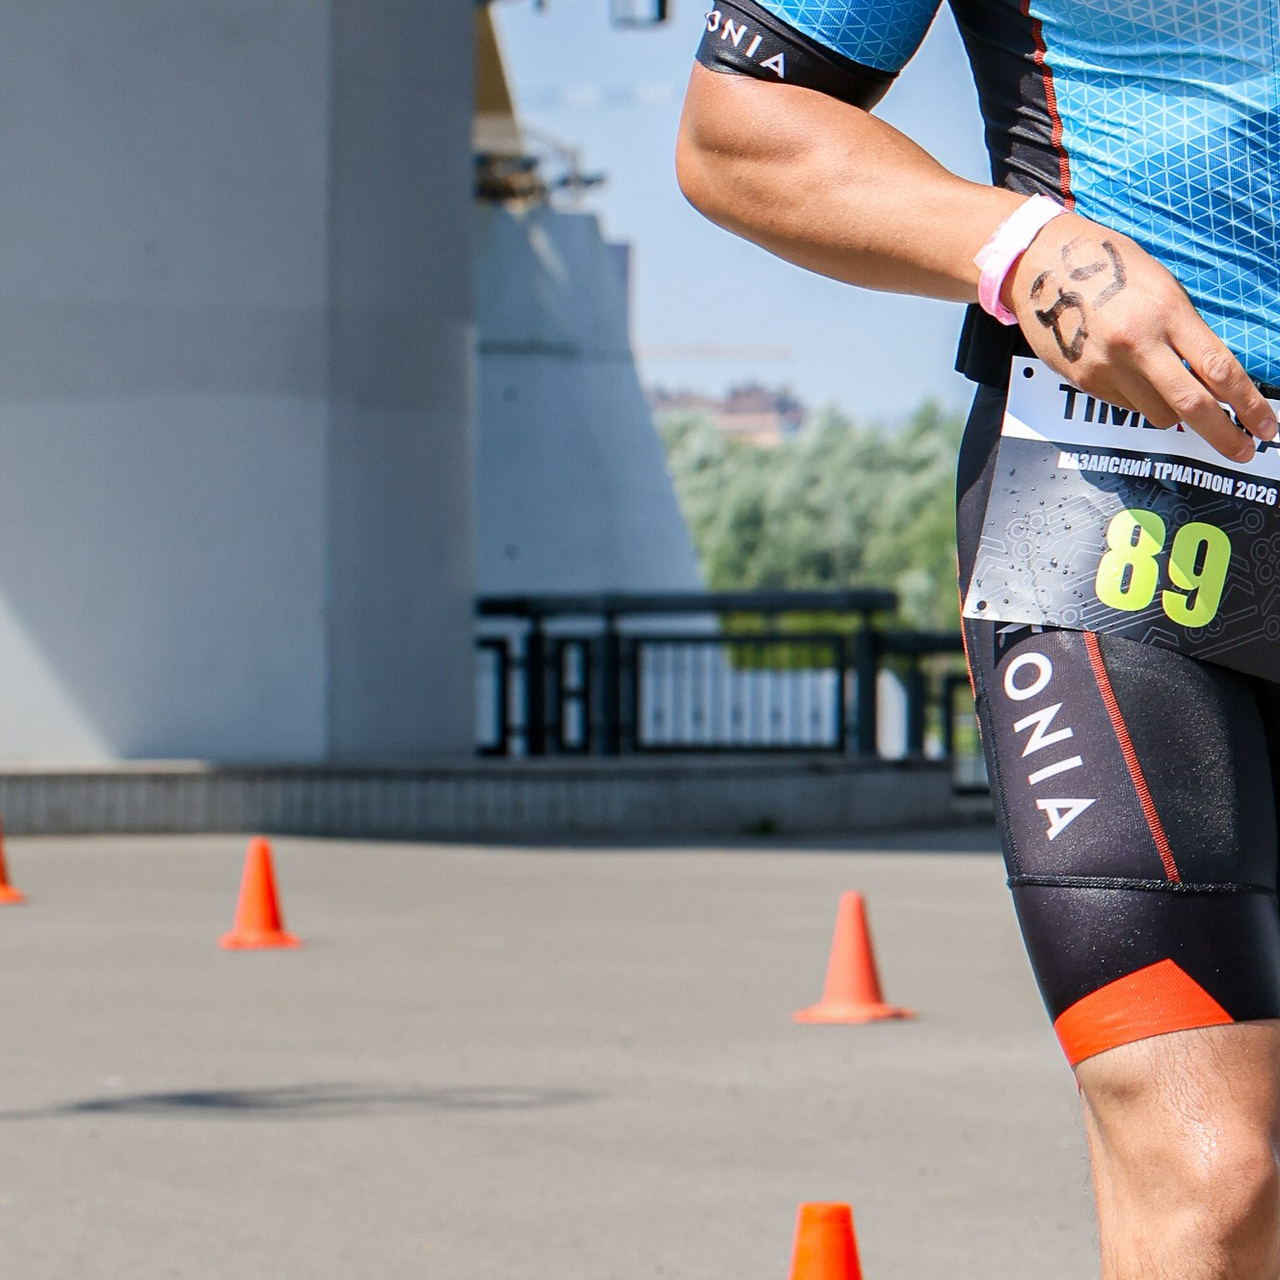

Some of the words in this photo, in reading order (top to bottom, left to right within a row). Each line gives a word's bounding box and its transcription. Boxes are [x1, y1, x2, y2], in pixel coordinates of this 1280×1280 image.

[1057, 450, 1152, 478] КАЗАНСКИЙ
[1153, 462, 1234, 495] ТРИАТЛОН
[1235, 481, 1278, 506] 2026
[1095, 508, 1231, 628] 89
